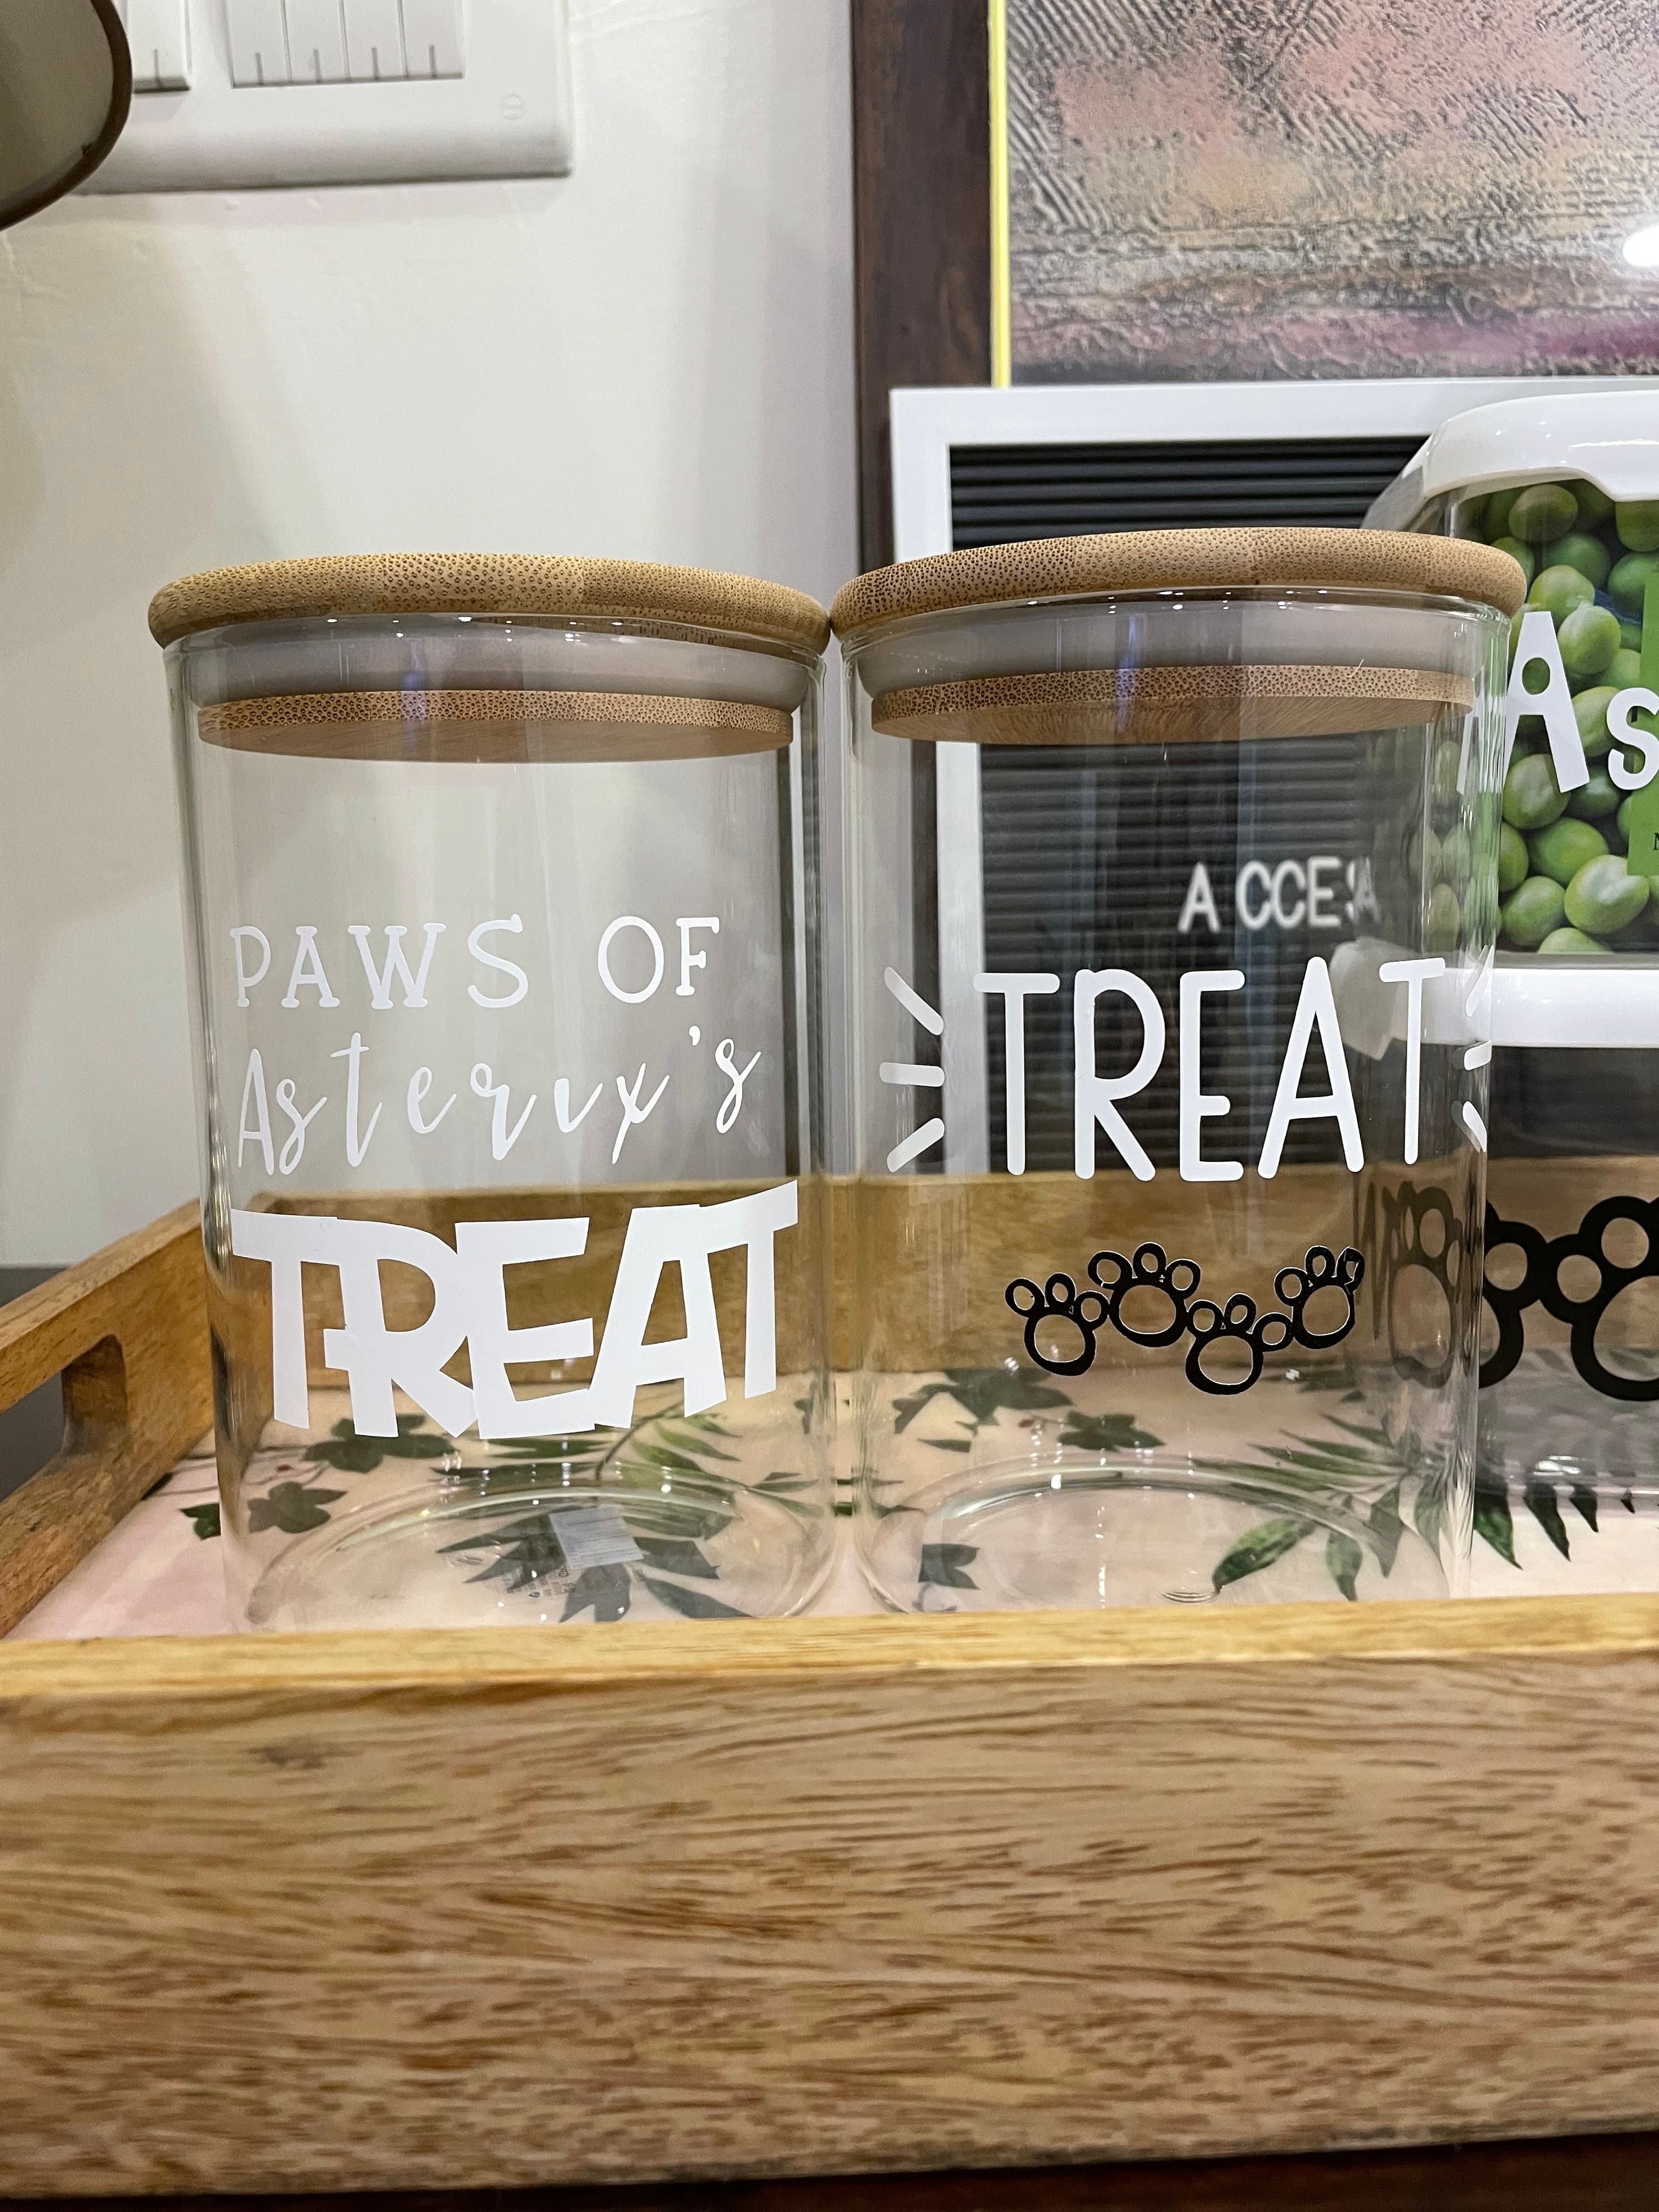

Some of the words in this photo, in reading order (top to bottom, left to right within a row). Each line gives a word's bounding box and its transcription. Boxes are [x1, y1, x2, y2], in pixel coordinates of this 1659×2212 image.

[229, 914, 529, 1010] PAWS
[597, 916, 721, 1005] OF
[237, 1024, 762, 1176] Asterix's
[973, 956, 1447, 1182] TREAT
[228, 1180, 798, 1439] TREAT
